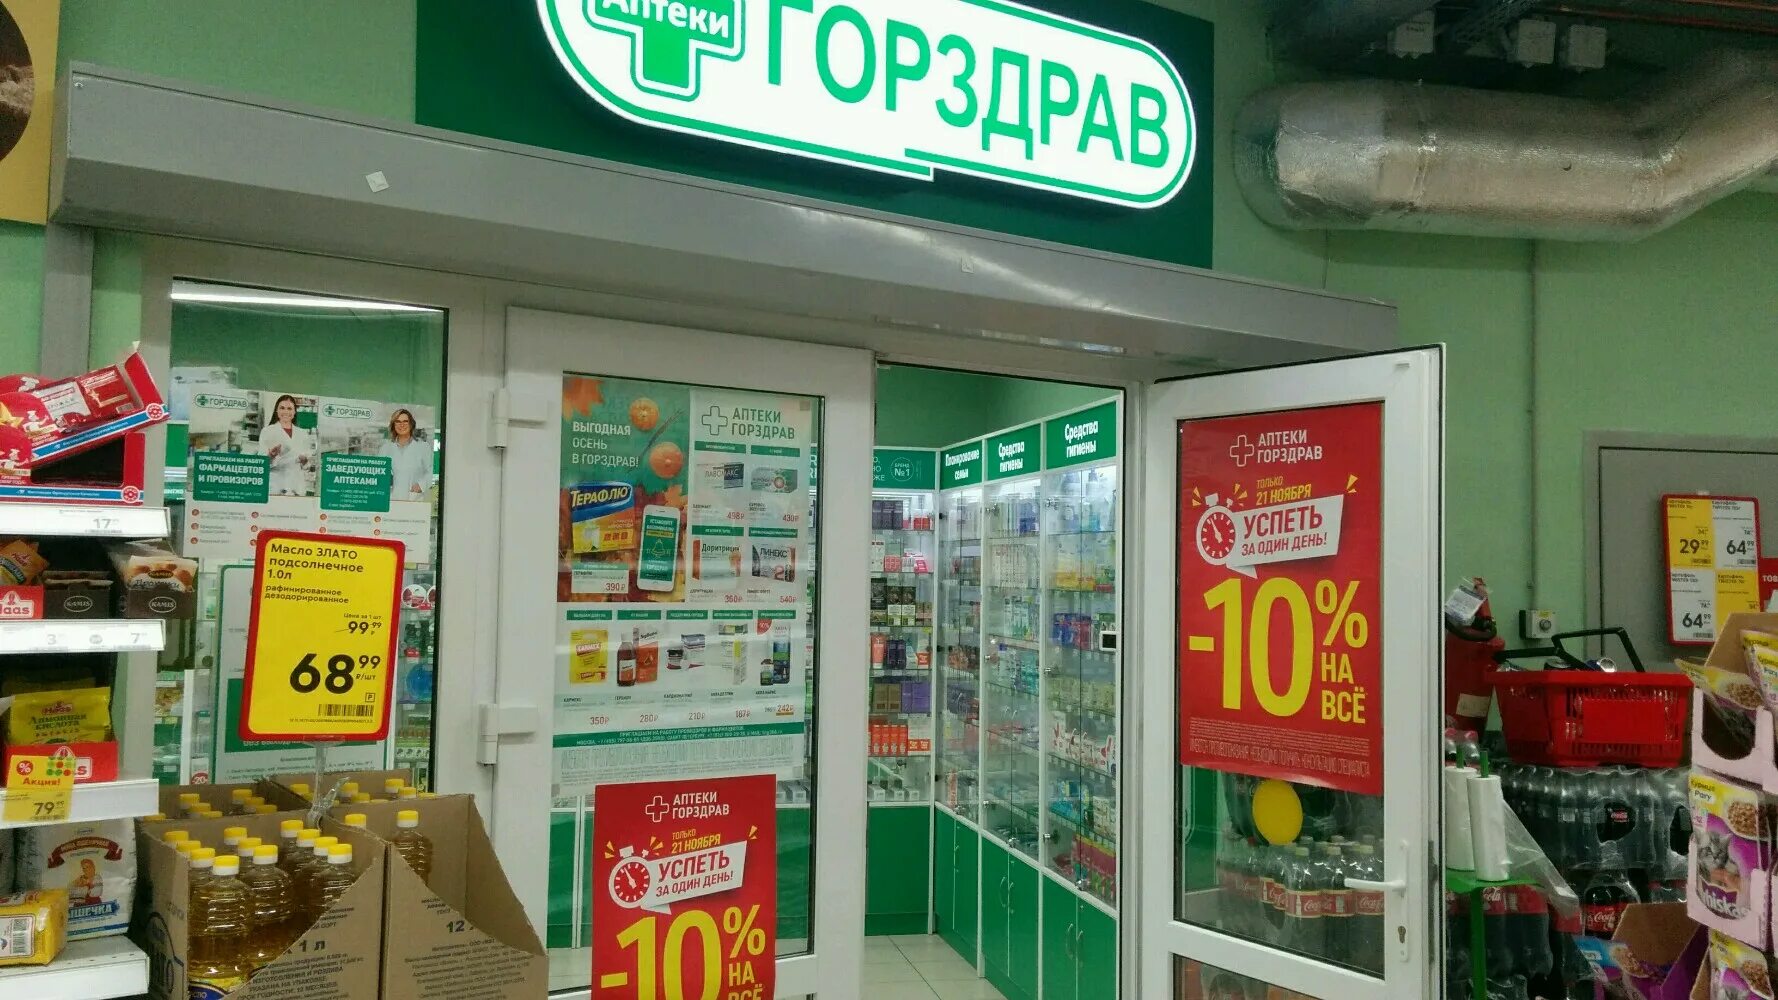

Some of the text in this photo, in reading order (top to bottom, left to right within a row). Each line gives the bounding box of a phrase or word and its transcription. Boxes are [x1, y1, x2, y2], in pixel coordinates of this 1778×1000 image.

[768, 0, 1171, 169] ГОРЗДРАВ
[210, 398, 248, 408] ГОРЗДРАВ
[336, 407, 371, 418] ГОРЗДРАВ
[732, 408, 781, 423] АПТЕКИ
[572, 421, 631, 437] ВЫГОДНАЯ
[731, 423, 795, 440] ГОРЗДРАВ
[1064, 420, 1099, 445] Средства
[572, 438, 608, 451] ОСЕНЬ
[1257, 430, 1308, 447] АПТЕКИ
[999, 440, 1025, 460] Средства
[1066, 439, 1097, 459] гигиены
[1257, 445, 1323, 464] ГОРЗДРАВ
[198, 463, 265, 476] ФАРМАЦЕВТОВ
[572, 454, 639, 469] В ГОРЗДРАВ!
[325, 464, 387, 477] ЗАВЕДУЮЩИХ
[198, 474, 264, 487] И ПРОВИЗОРОВ
[333, 475, 378, 487] АПТЕКАМИ
[1256, 476, 1284, 489] ТОЛЬКО
[1256, 484, 1313, 506] 21 НОЯБРЯ
[1243, 505, 1324, 539] УСПЕТЬ
[270, 544, 358, 561] Масло ЗЛАТО
[1242, 532, 1328, 557] ЗА ОДИН ДЕНЬ!
[1679, 538, 1701, 554] 29
[1727, 539, 1747, 555] 64
[268, 558, 364, 574] подсолнечное
[267, 569, 292, 581] 1.0л
[264, 592, 350, 604] дезодорированное
[265, 585, 342, 597] рафинированное
[347, 621, 369, 635] 99
[1682, 613, 1704, 629] 64
[1189, 577, 1369, 717] -10%
[289, 652, 381, 695] 68 99
[1321, 652, 1355, 685] НА
[1321, 687, 1367, 725] ВСЁ
[22, 778, 61, 786] Акция!
[672, 792, 718, 806] АПТЕКИ
[34, 801, 55, 816] 79
[671, 804, 730, 820] ГОРЗДРАВ
[672, 828, 697, 840] ТОЛЬКО
[671, 834, 722, 855] 21 НОЯБРЯ
[657, 851, 730, 883] УСПЕТЬ
[655, 870, 734, 898] ЗА ОДИН ДЕНЬ!
[446, 920, 465, 932] 12
[728, 960, 756, 987] НА
